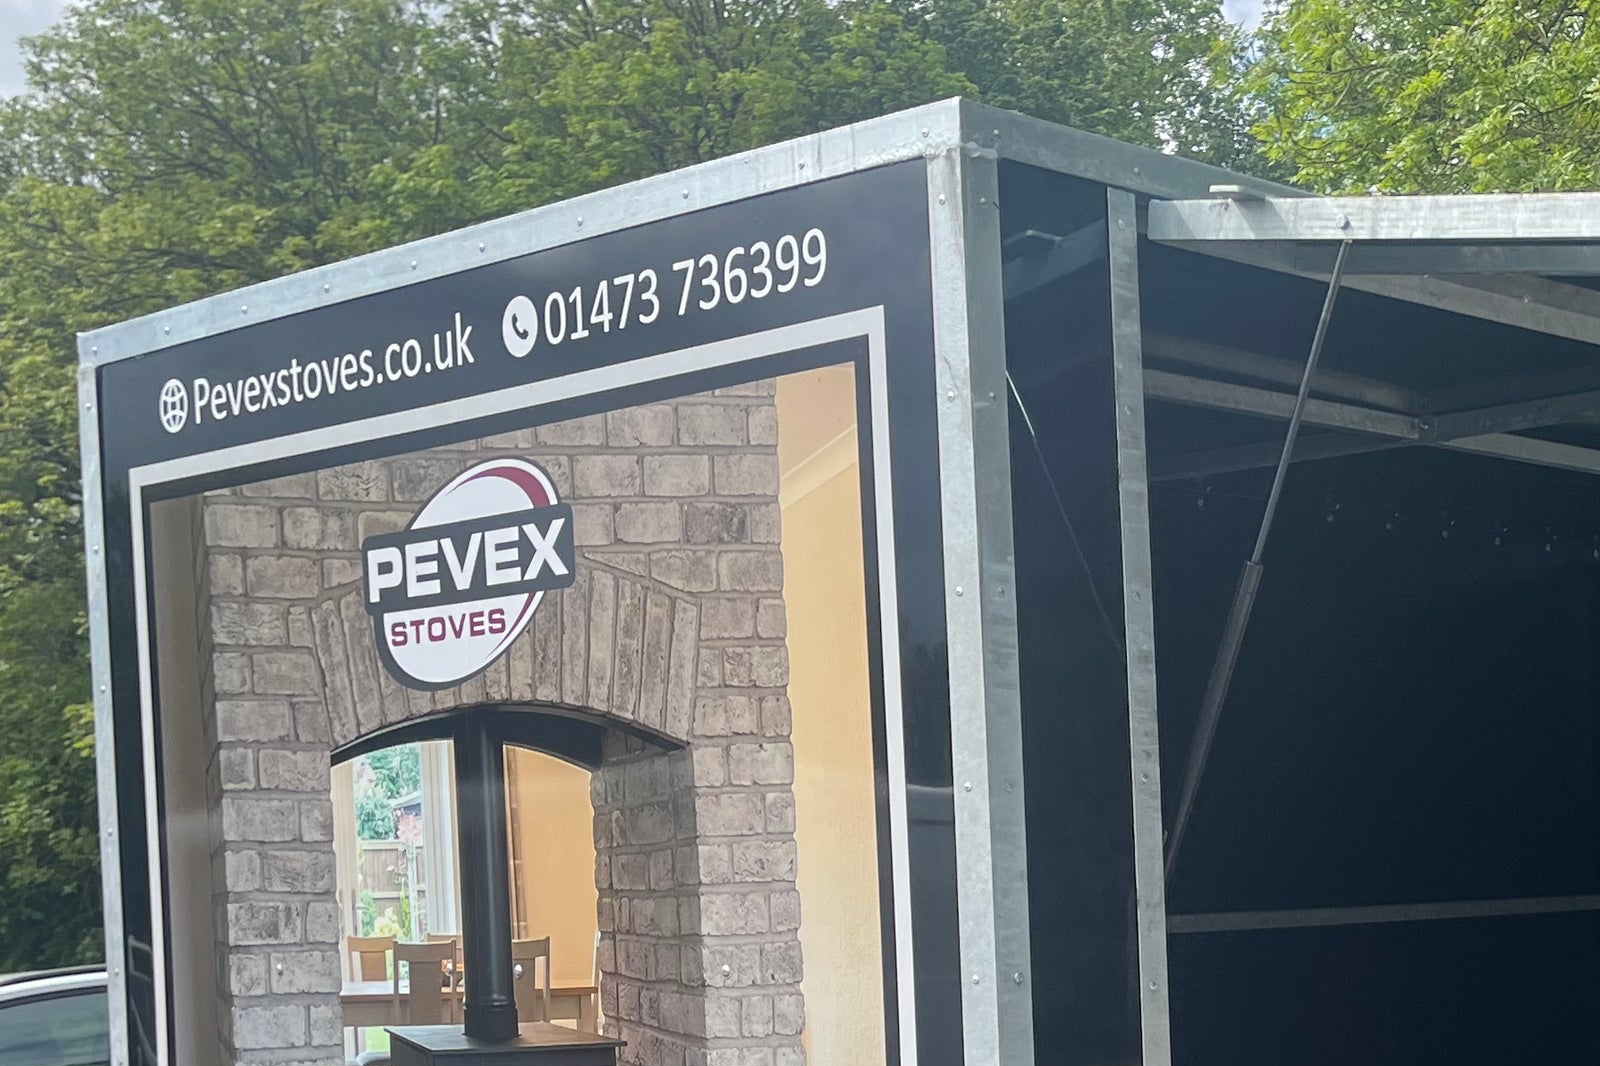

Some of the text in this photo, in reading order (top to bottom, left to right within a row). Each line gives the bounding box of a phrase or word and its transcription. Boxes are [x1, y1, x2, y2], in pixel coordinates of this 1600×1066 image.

[544, 227, 827, 345] 01473 736399
[193, 312, 475, 425] Pevexstoves.co.uk
[367, 517, 569, 603] PEVEX
[391, 608, 506, 647] STOVES
